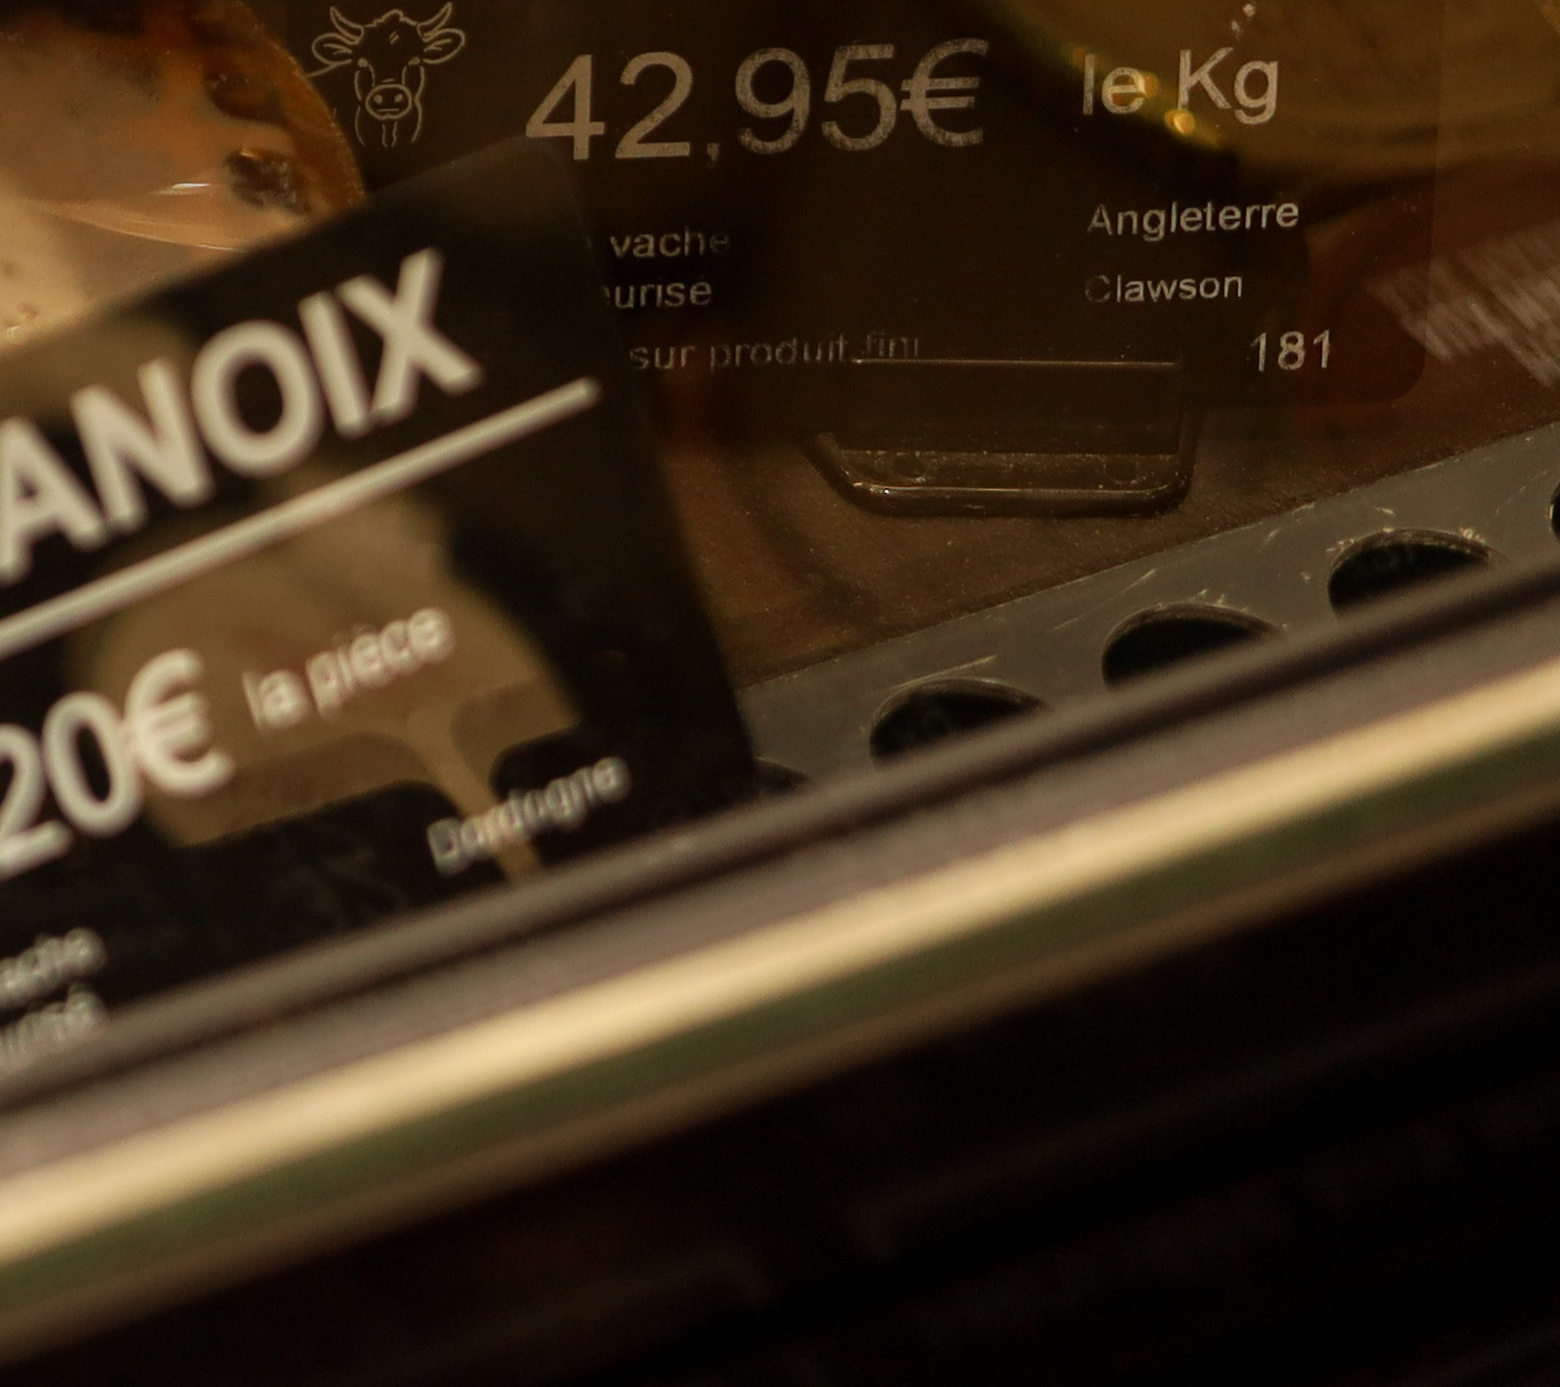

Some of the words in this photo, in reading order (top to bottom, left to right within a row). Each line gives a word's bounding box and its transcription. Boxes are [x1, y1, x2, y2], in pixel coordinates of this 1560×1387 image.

[524, 36, 989, 167] 42,95€
[1081, 51, 1147, 118] le
[1176, 43, 1280, 125] Kg
[1088, 200, 1300, 242] Angleterre
[609, 226, 731, 260] vache
[1084, 274, 1243, 304] Clawson
[628, 344, 697, 371] sur
[709, 332, 849, 373] produit
[1250, 329, 1332, 373] 181
[242, 665, 305, 731] la
[303, 604, 457, 715] pièce
